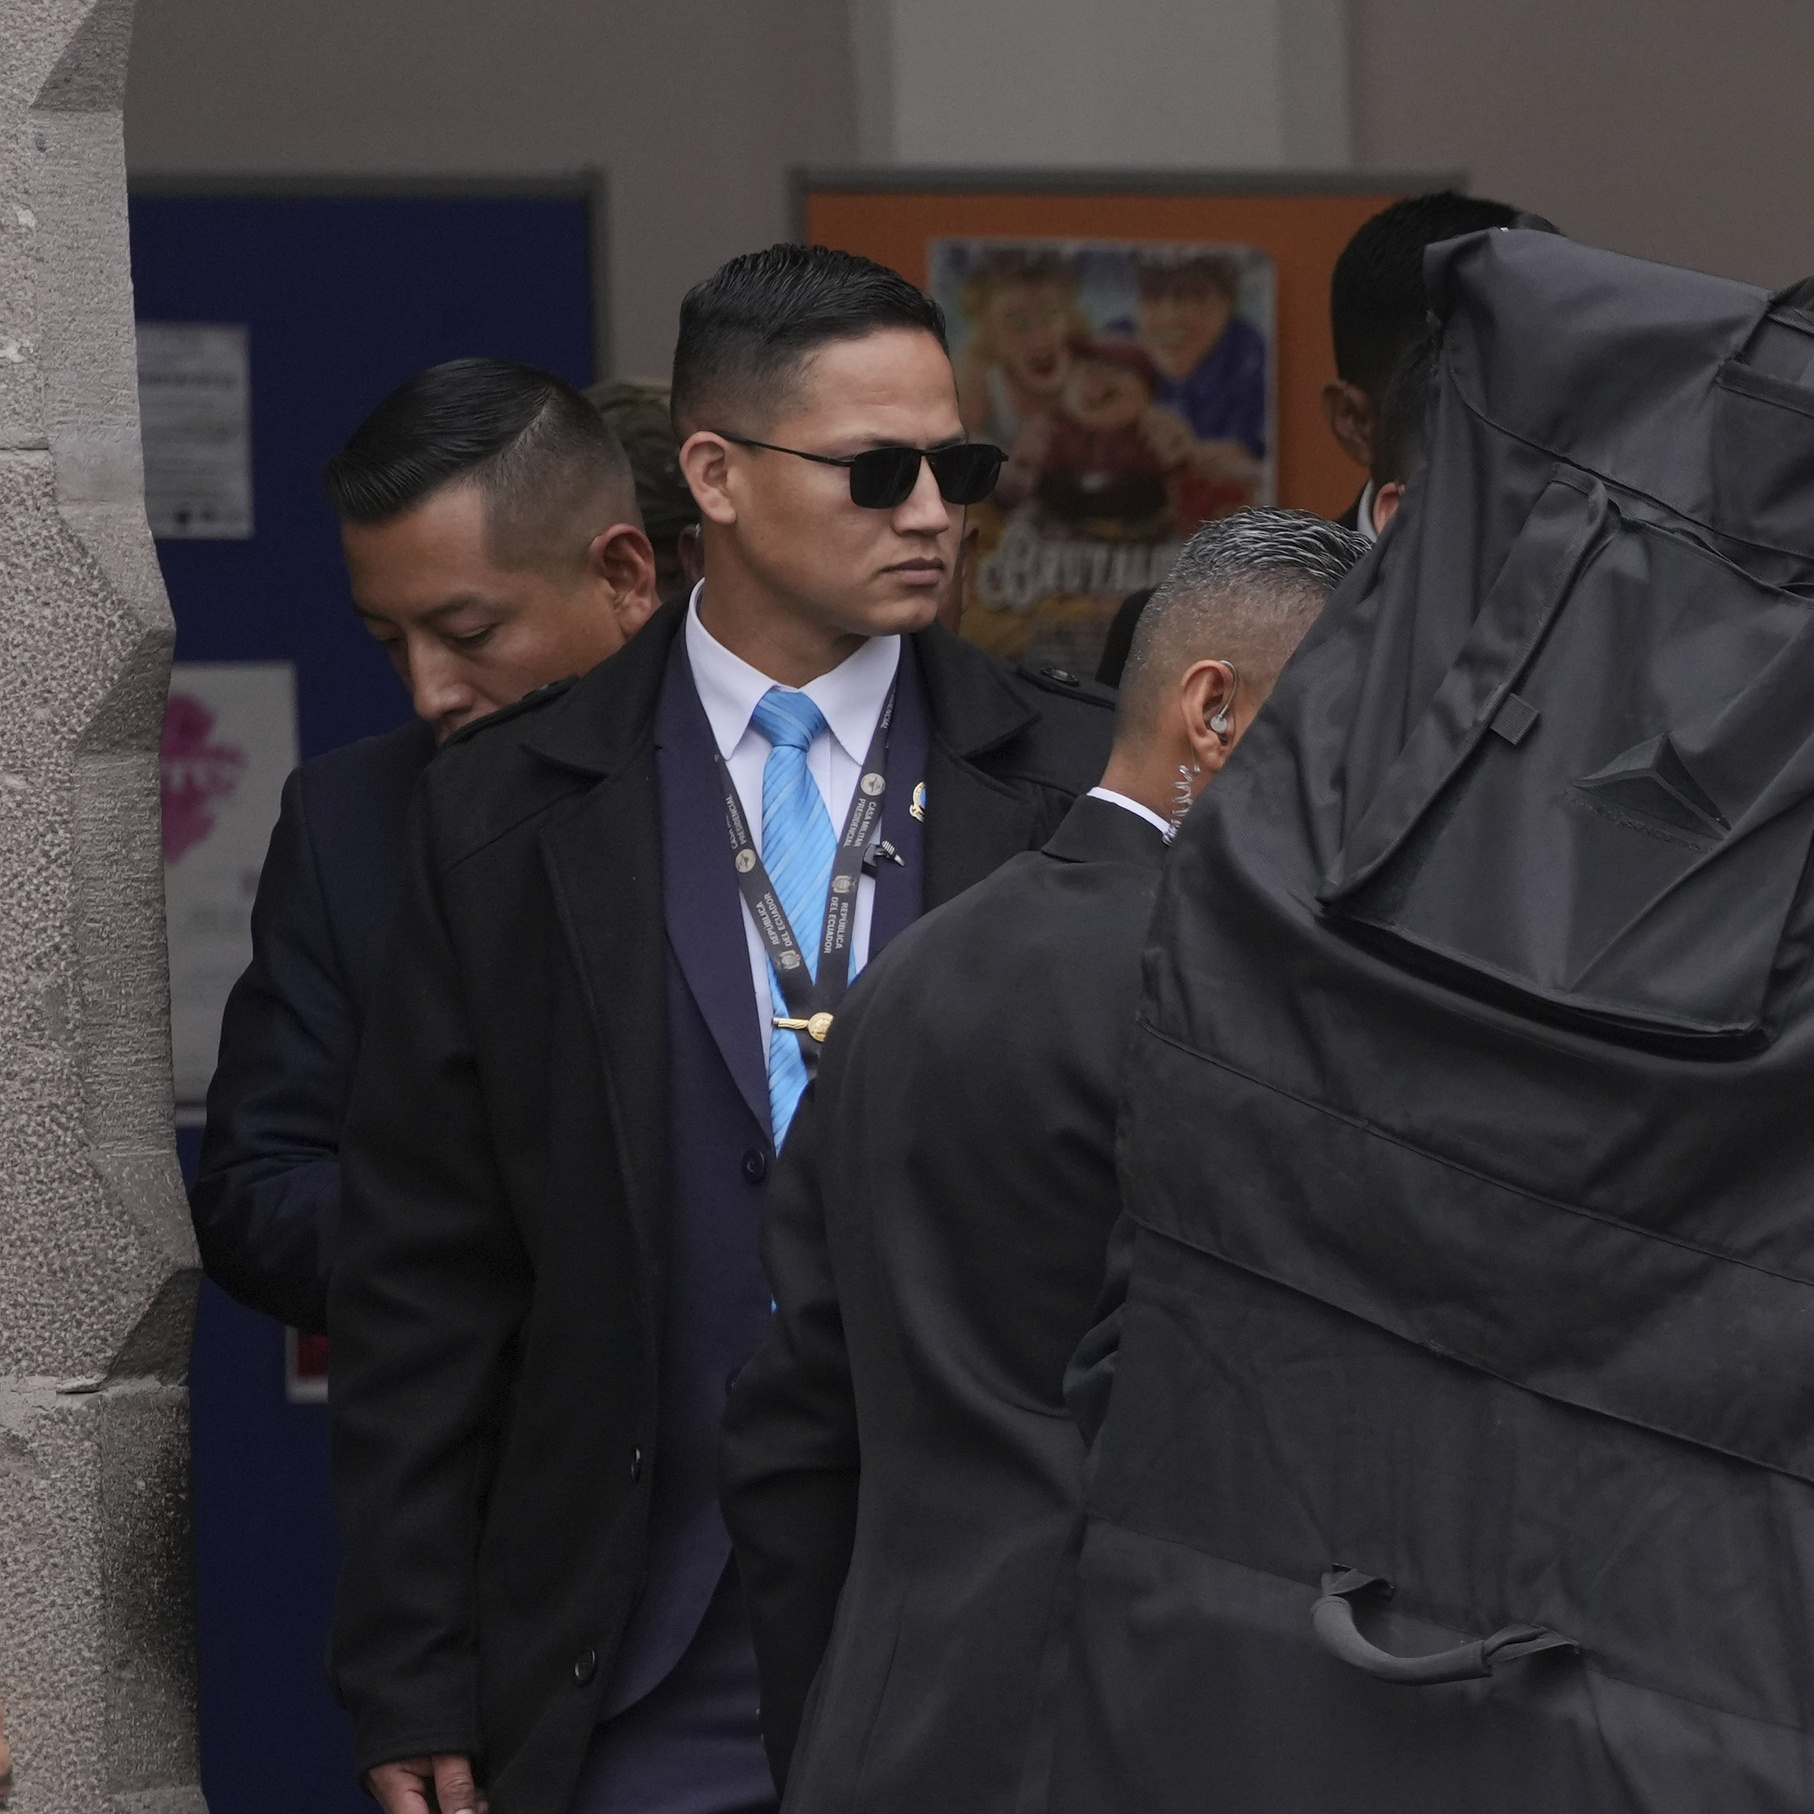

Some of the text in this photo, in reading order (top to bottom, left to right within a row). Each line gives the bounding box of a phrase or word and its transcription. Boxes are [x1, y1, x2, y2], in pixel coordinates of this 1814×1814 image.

[725, 793, 747, 846] PRESIDENCIAL
[842, 797, 867, 848] PRESIDENCIAL
[853, 801, 877, 847] CASA MILITAR
[763, 892, 793, 947] DEL ECUADOR
[823, 896, 839, 954] DEL ECUADOR
